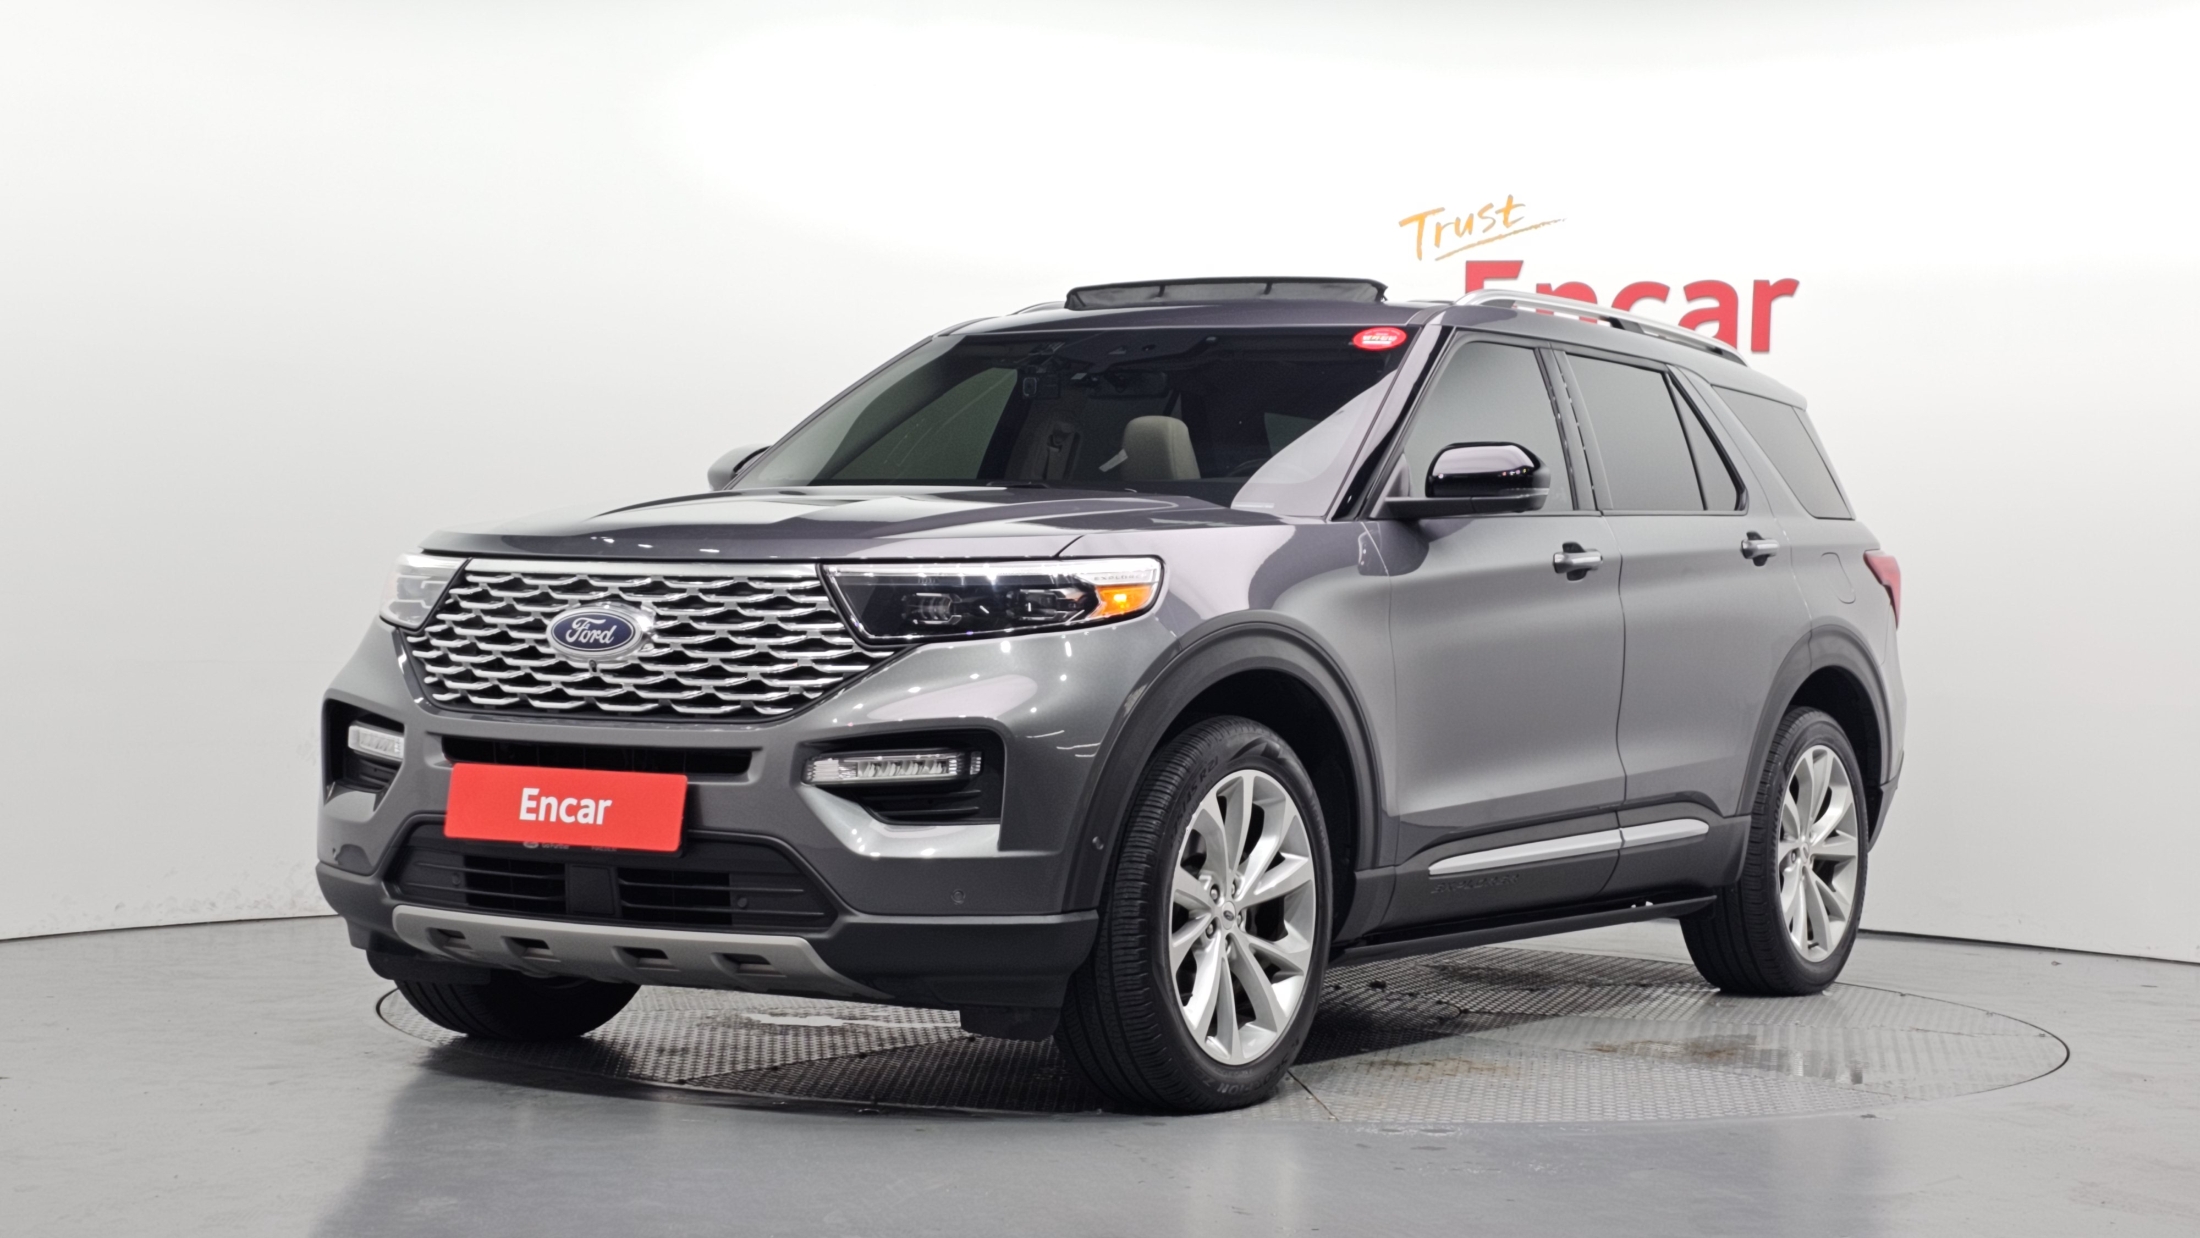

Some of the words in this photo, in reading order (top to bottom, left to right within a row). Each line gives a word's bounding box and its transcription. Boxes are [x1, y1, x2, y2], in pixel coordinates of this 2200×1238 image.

[1398, 194, 1525, 261] Trust
[565, 617, 617, 644] Ford
[519, 787, 613, 825] Encar
